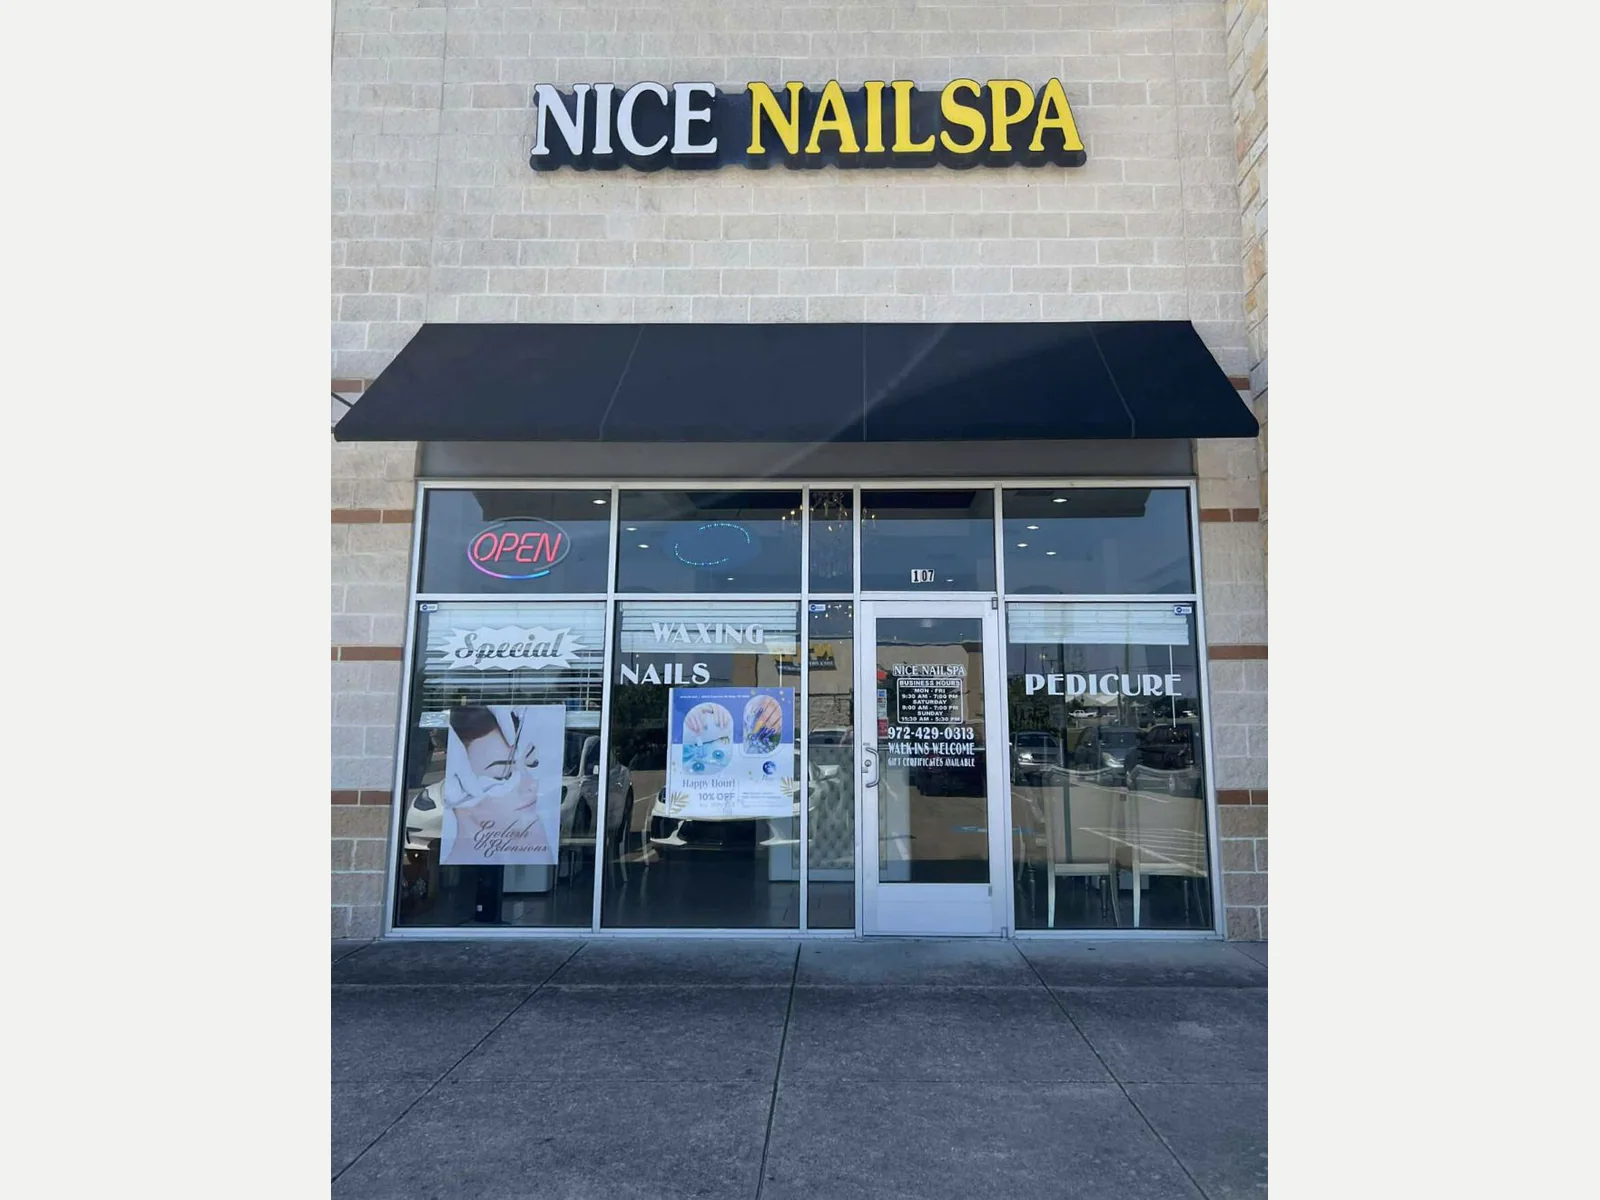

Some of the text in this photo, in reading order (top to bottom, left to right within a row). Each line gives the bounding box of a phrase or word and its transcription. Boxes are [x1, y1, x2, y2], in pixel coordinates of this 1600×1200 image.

[531, 78, 1085, 156] NICE NAILSPA
[472, 532, 562, 563] OPEN
[911, 569, 934, 583] 107
[651, 620, 765, 646] WAXING
[454, 632, 565, 663] Special
[619, 662, 711, 686] NAILS
[893, 664, 966, 676] NICE NAILSPA
[1025, 673, 1183, 697] PEDICURE
[888, 726, 975, 740] 972-429-0313
[888, 742, 975, 755] WALK-INS WELCOME
[888, 757, 975, 767] GIFT CERTIFICATES AVAILABLE
[682, 779, 736, 789] Happy Hour!
[699, 792, 715, 801] 10%
[717, 792, 735, 801] OFF
[474, 820, 537, 846] Eyelash
